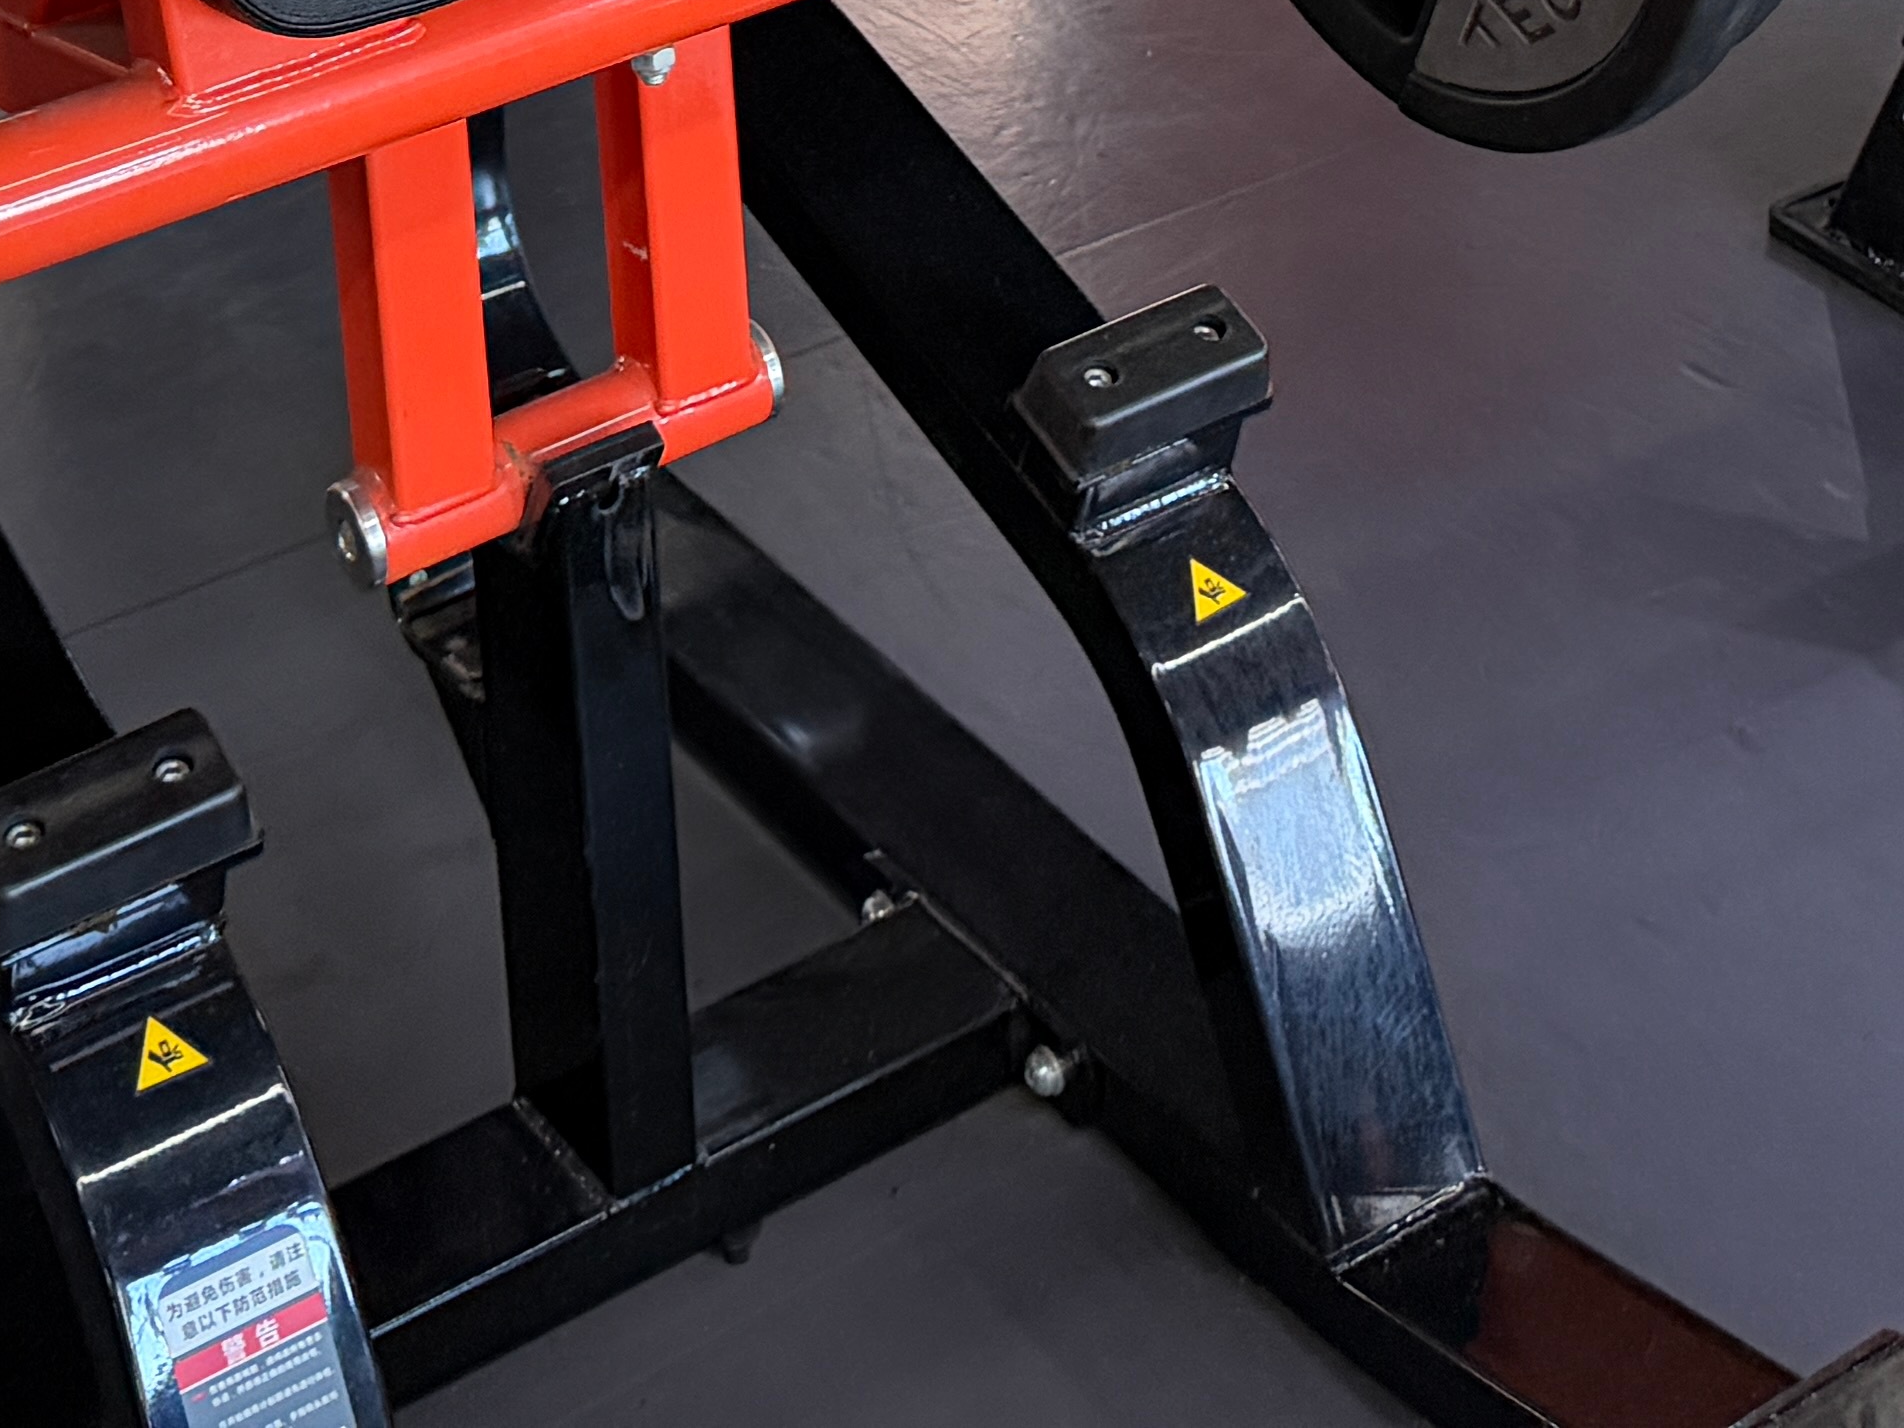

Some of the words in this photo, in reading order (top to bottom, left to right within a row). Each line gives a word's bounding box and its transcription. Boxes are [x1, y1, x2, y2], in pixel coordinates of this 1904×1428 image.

[181, 1269, 303, 1341] 意以下防范措施
[220, 1318, 282, 1366] 警告
